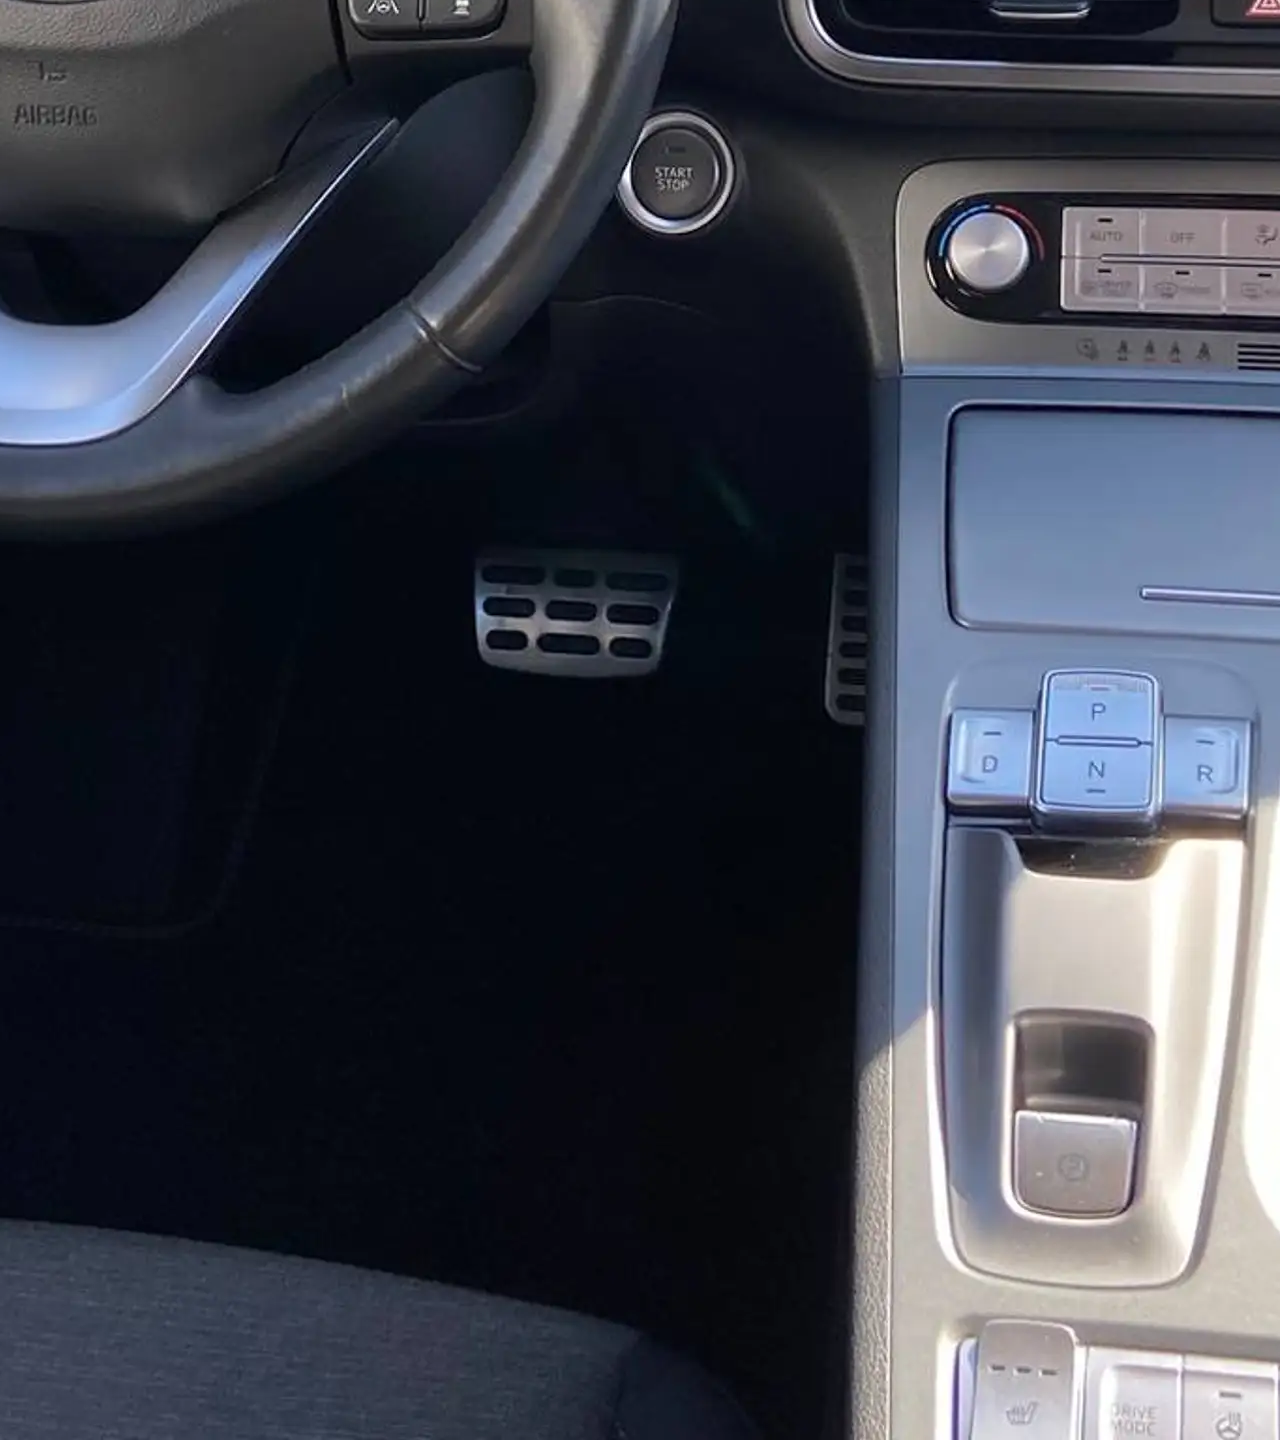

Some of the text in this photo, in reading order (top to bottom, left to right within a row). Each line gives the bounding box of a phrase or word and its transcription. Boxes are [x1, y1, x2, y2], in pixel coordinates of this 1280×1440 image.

[14, 103, 98, 127] AIRBAG
[654, 166, 694, 178] START
[657, 178, 690, 191] STOP
[1089, 230, 1124, 243] AUTO
[1169, 232, 1196, 244] OFF
[1091, 702, 1107, 721] P
[981, 755, 999, 774] D
[1088, 761, 1106, 779] N
[1197, 765, 1214, 783] R
